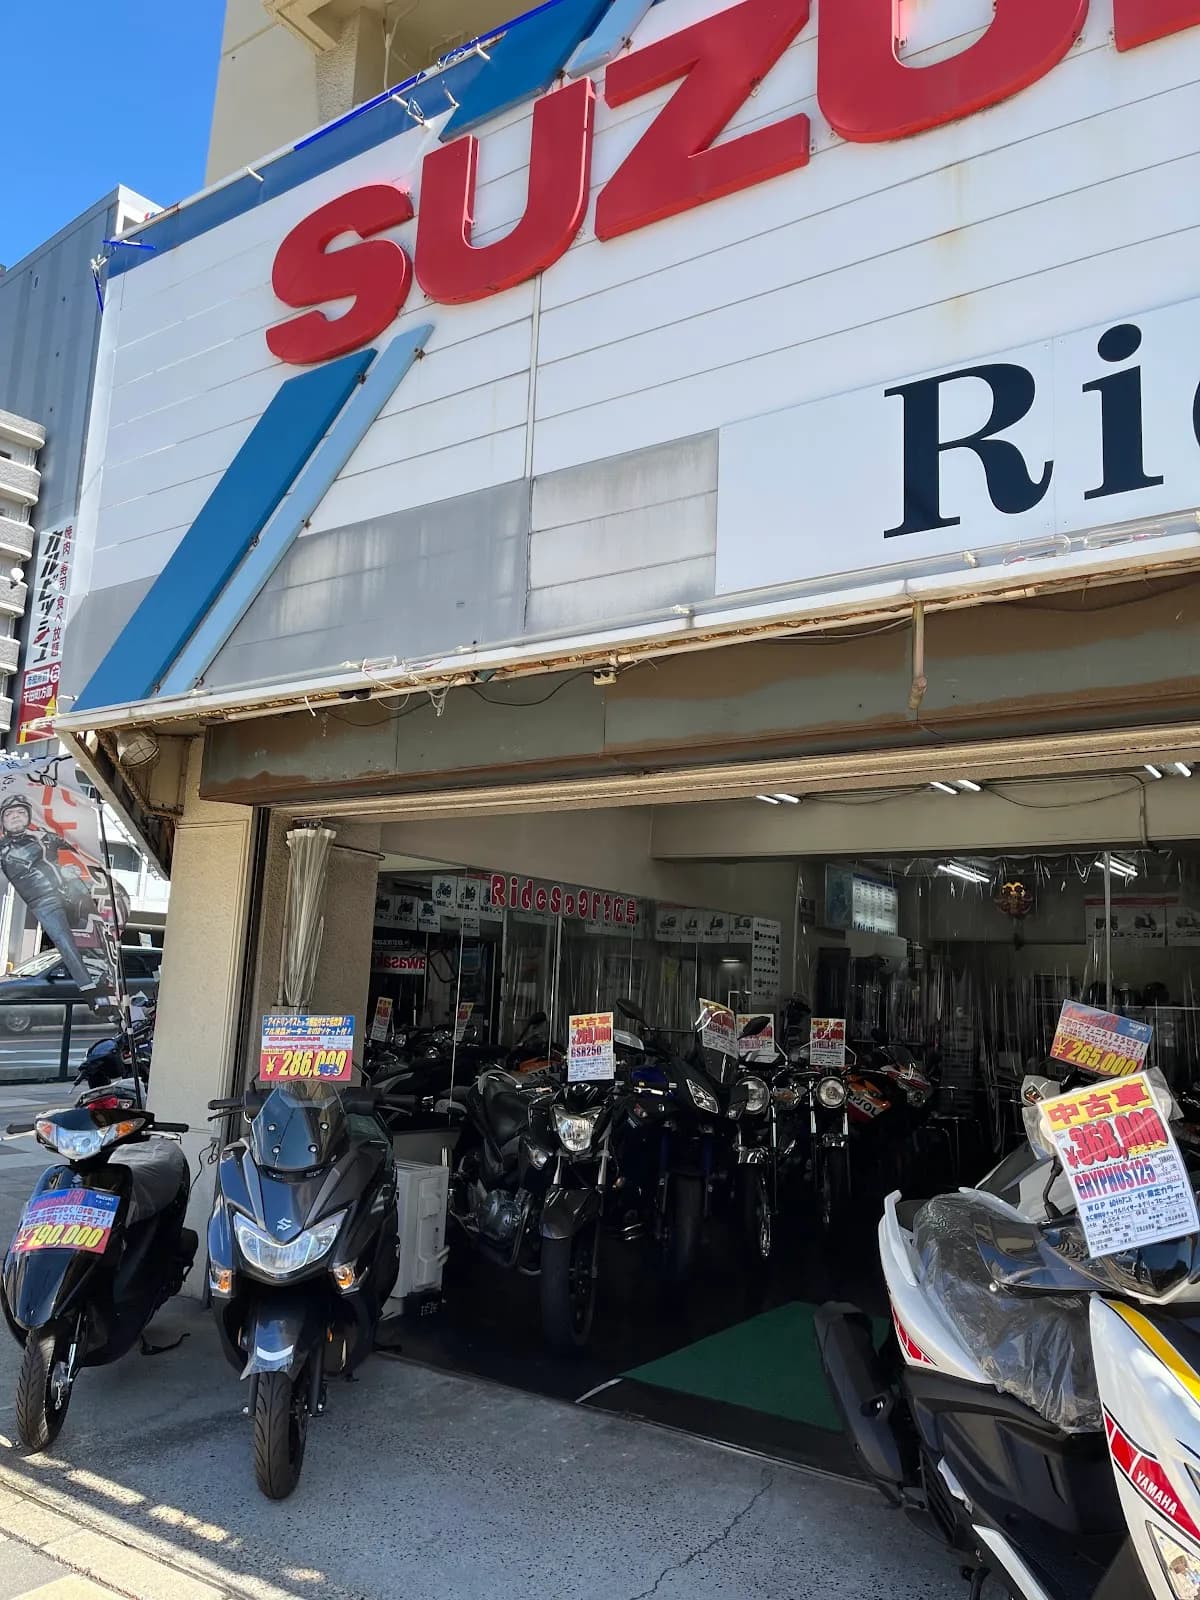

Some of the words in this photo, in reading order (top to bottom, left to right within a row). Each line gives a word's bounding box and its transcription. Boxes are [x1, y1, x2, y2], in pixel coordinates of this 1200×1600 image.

[266, 0, 1200, 365] SUZU
[884, 323, 1200, 539] Ri
[572, 1016, 610, 1028] 中古車
[571, 1045, 601, 1057] GSR250
[1048, 1082, 1150, 1124] 中古車
[1073, 1157, 1156, 1200] GRYPHUS125
[1135, 1471, 1179, 1516] YAMAHA
